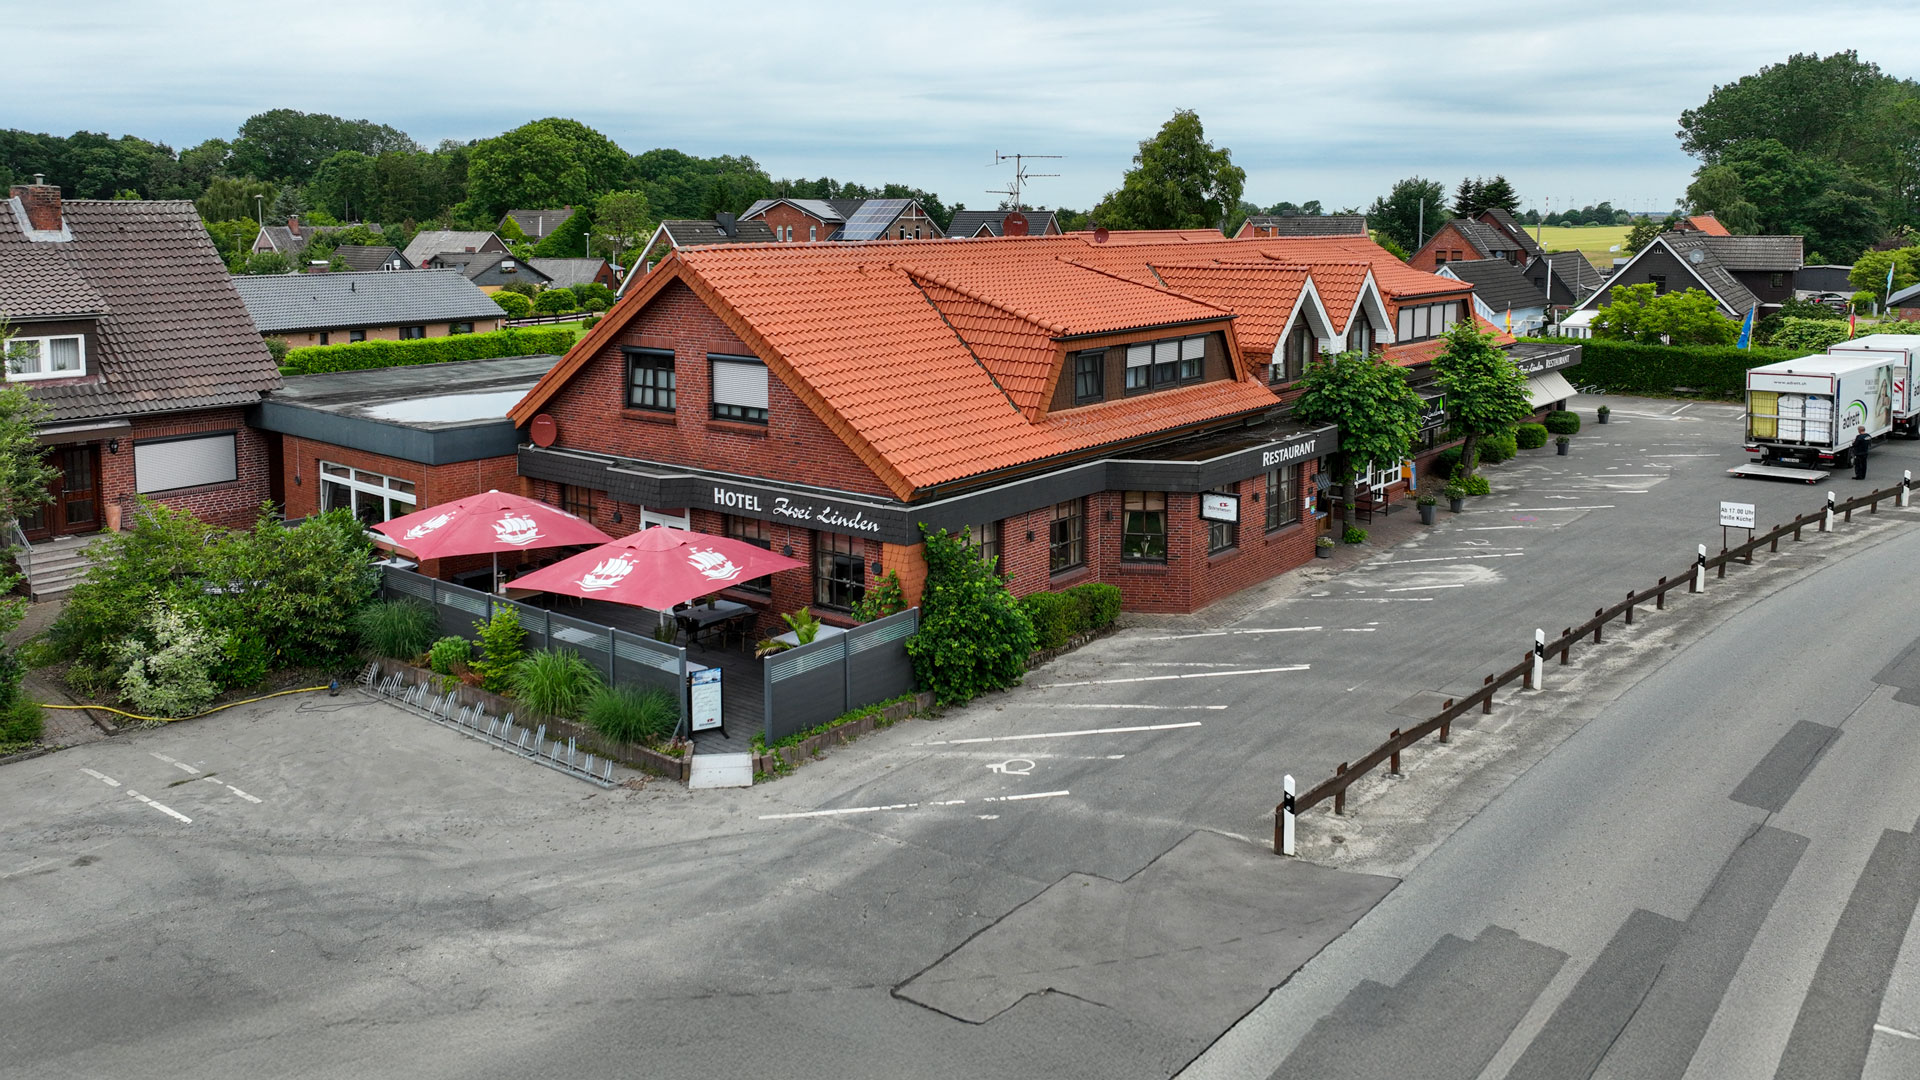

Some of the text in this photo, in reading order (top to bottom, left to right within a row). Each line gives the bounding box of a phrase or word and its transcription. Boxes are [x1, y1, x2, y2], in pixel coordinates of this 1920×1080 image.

[1545, 354, 1570, 369] RESTAURANT
[1262, 440, 1316, 467] RESTAURANT
[714, 487, 881, 533] HOTEL Zwei Linden
